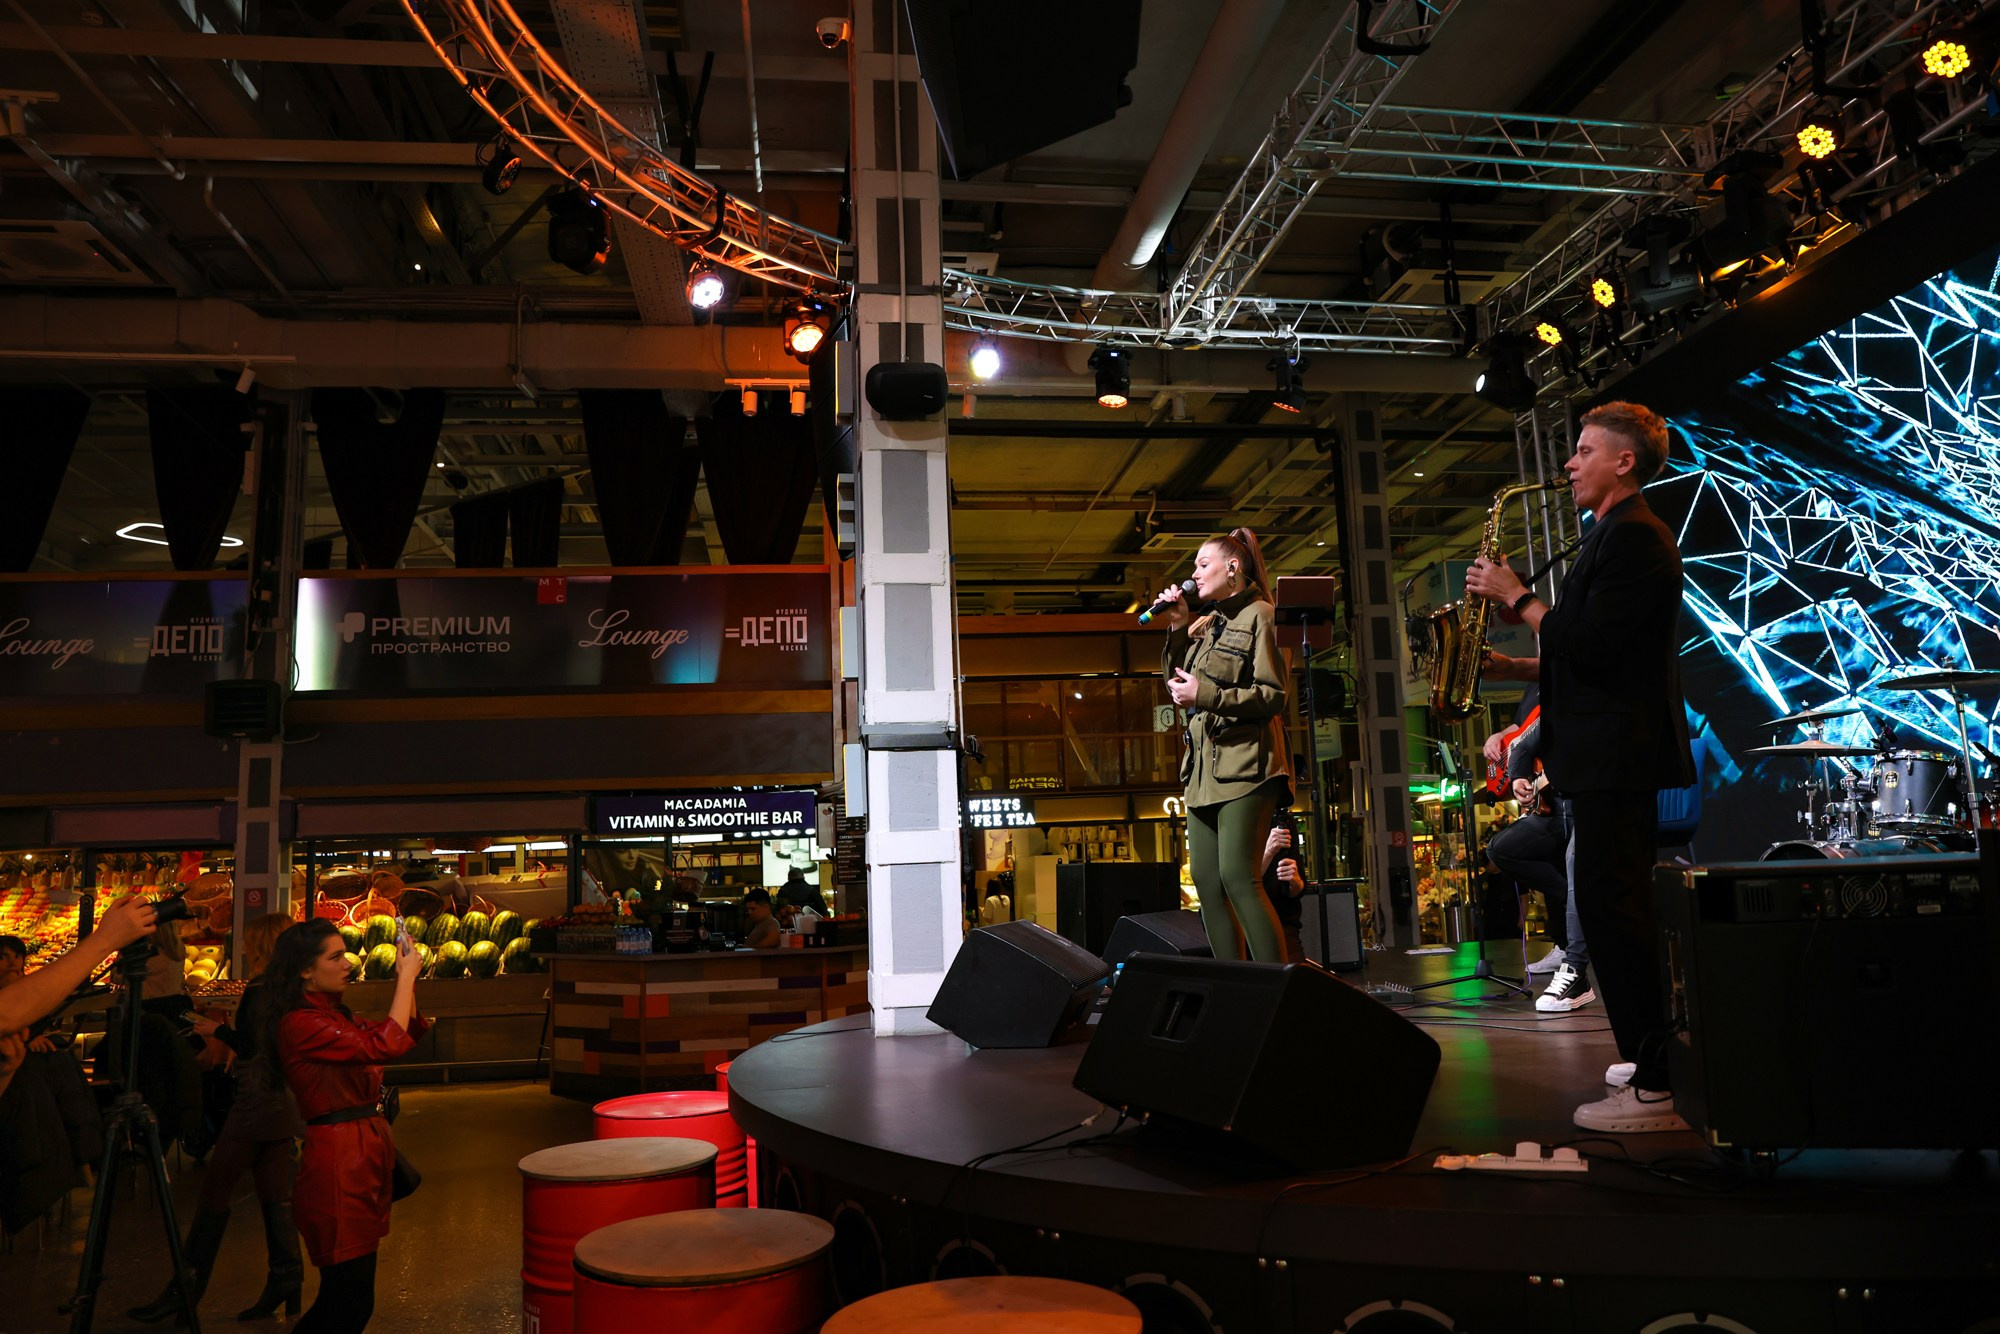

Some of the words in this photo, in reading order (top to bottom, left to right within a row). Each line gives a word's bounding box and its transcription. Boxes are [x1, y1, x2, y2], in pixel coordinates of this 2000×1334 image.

[371, 616, 511, 637] PREMIUM
[578, 608, 690, 660] Lounge
[371, 641, 511, 655] ПРОСТРАНСТВО
[780, 644, 808, 652] МОСКВА
[664, 797, 748, 811] MACADAMIA
[958, 798, 1021, 813] WEETS
[608, 815, 675, 830] VITAMIN
[676, 817, 687, 828] &
[688, 811, 769, 828] SMOOTHIE
[772, 810, 803, 825] BAR
[1006, 812, 1036, 826] TEA
